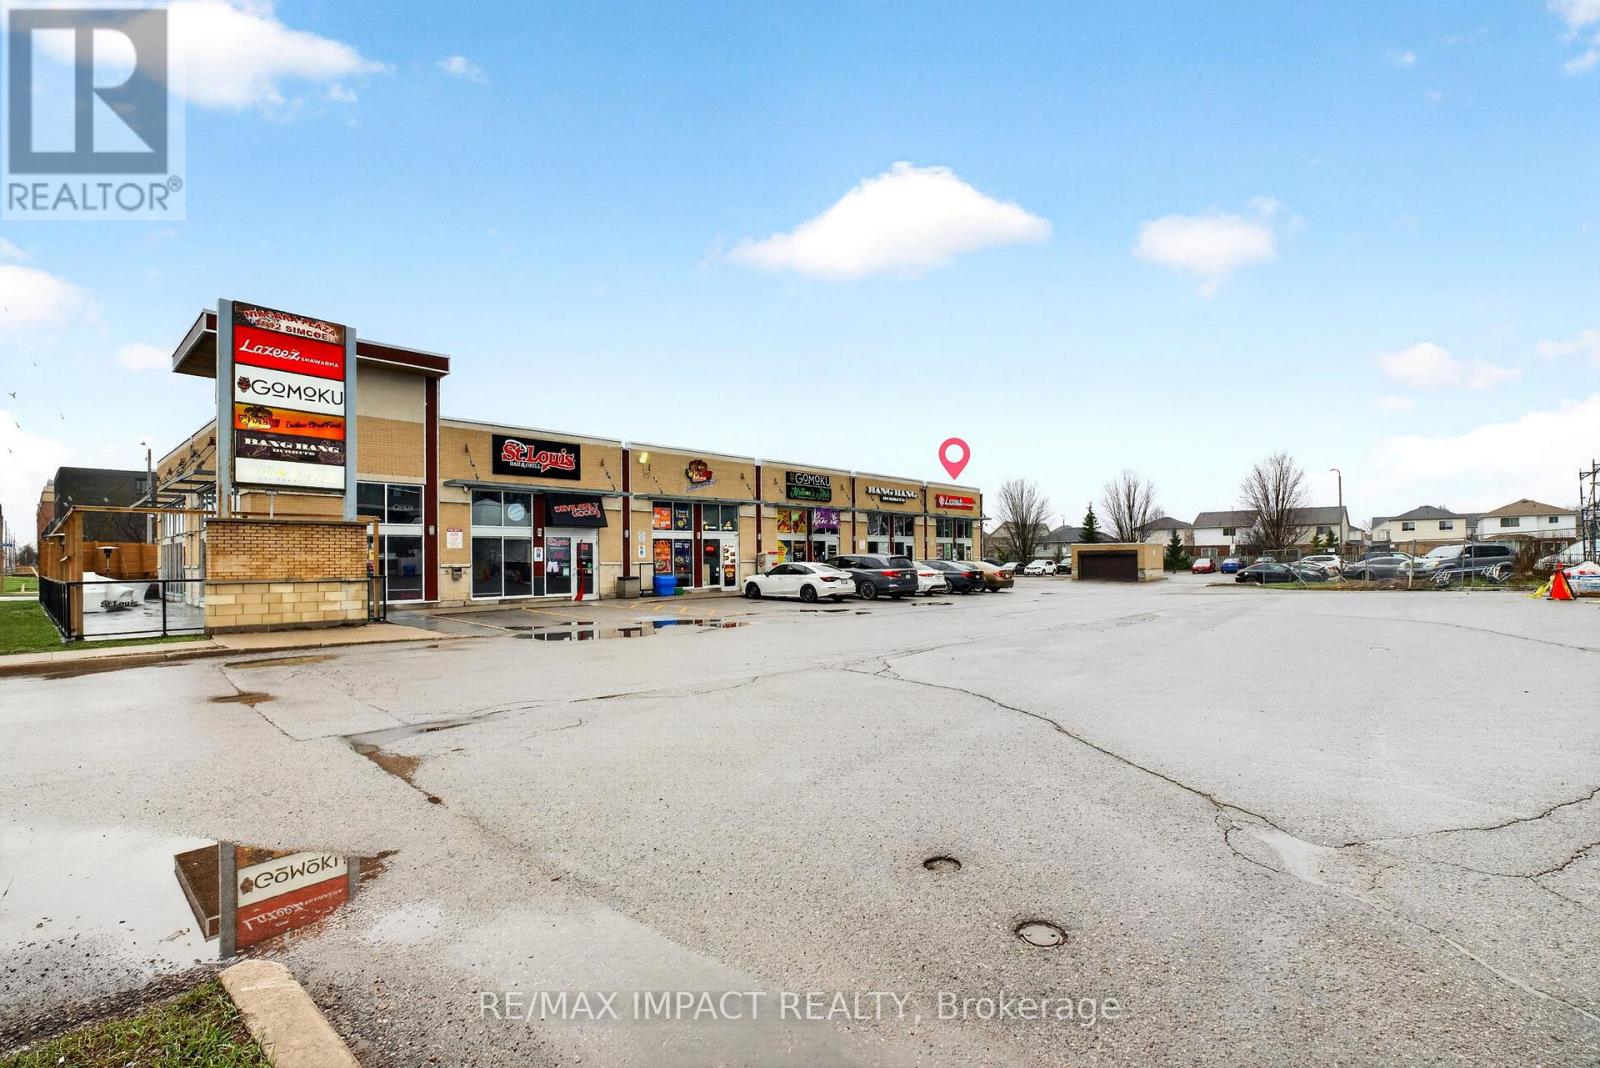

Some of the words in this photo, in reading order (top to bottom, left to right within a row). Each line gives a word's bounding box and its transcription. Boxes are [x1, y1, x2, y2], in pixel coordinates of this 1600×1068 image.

[285, 325, 329, 340] SIMCOE
[301, 318, 336, 337] PLAZA
[300, 357, 339, 368] SHAWARMA
[251, 379, 344, 405] GOMOKU
[244, 437, 293, 449] BANG
[295, 442, 341, 454] BANG
[525, 444, 576, 473] Louis
[795, 473, 832, 487] GOMOKU
[868, 486, 894, 496] BANG
[894, 489, 918, 499] BANG
